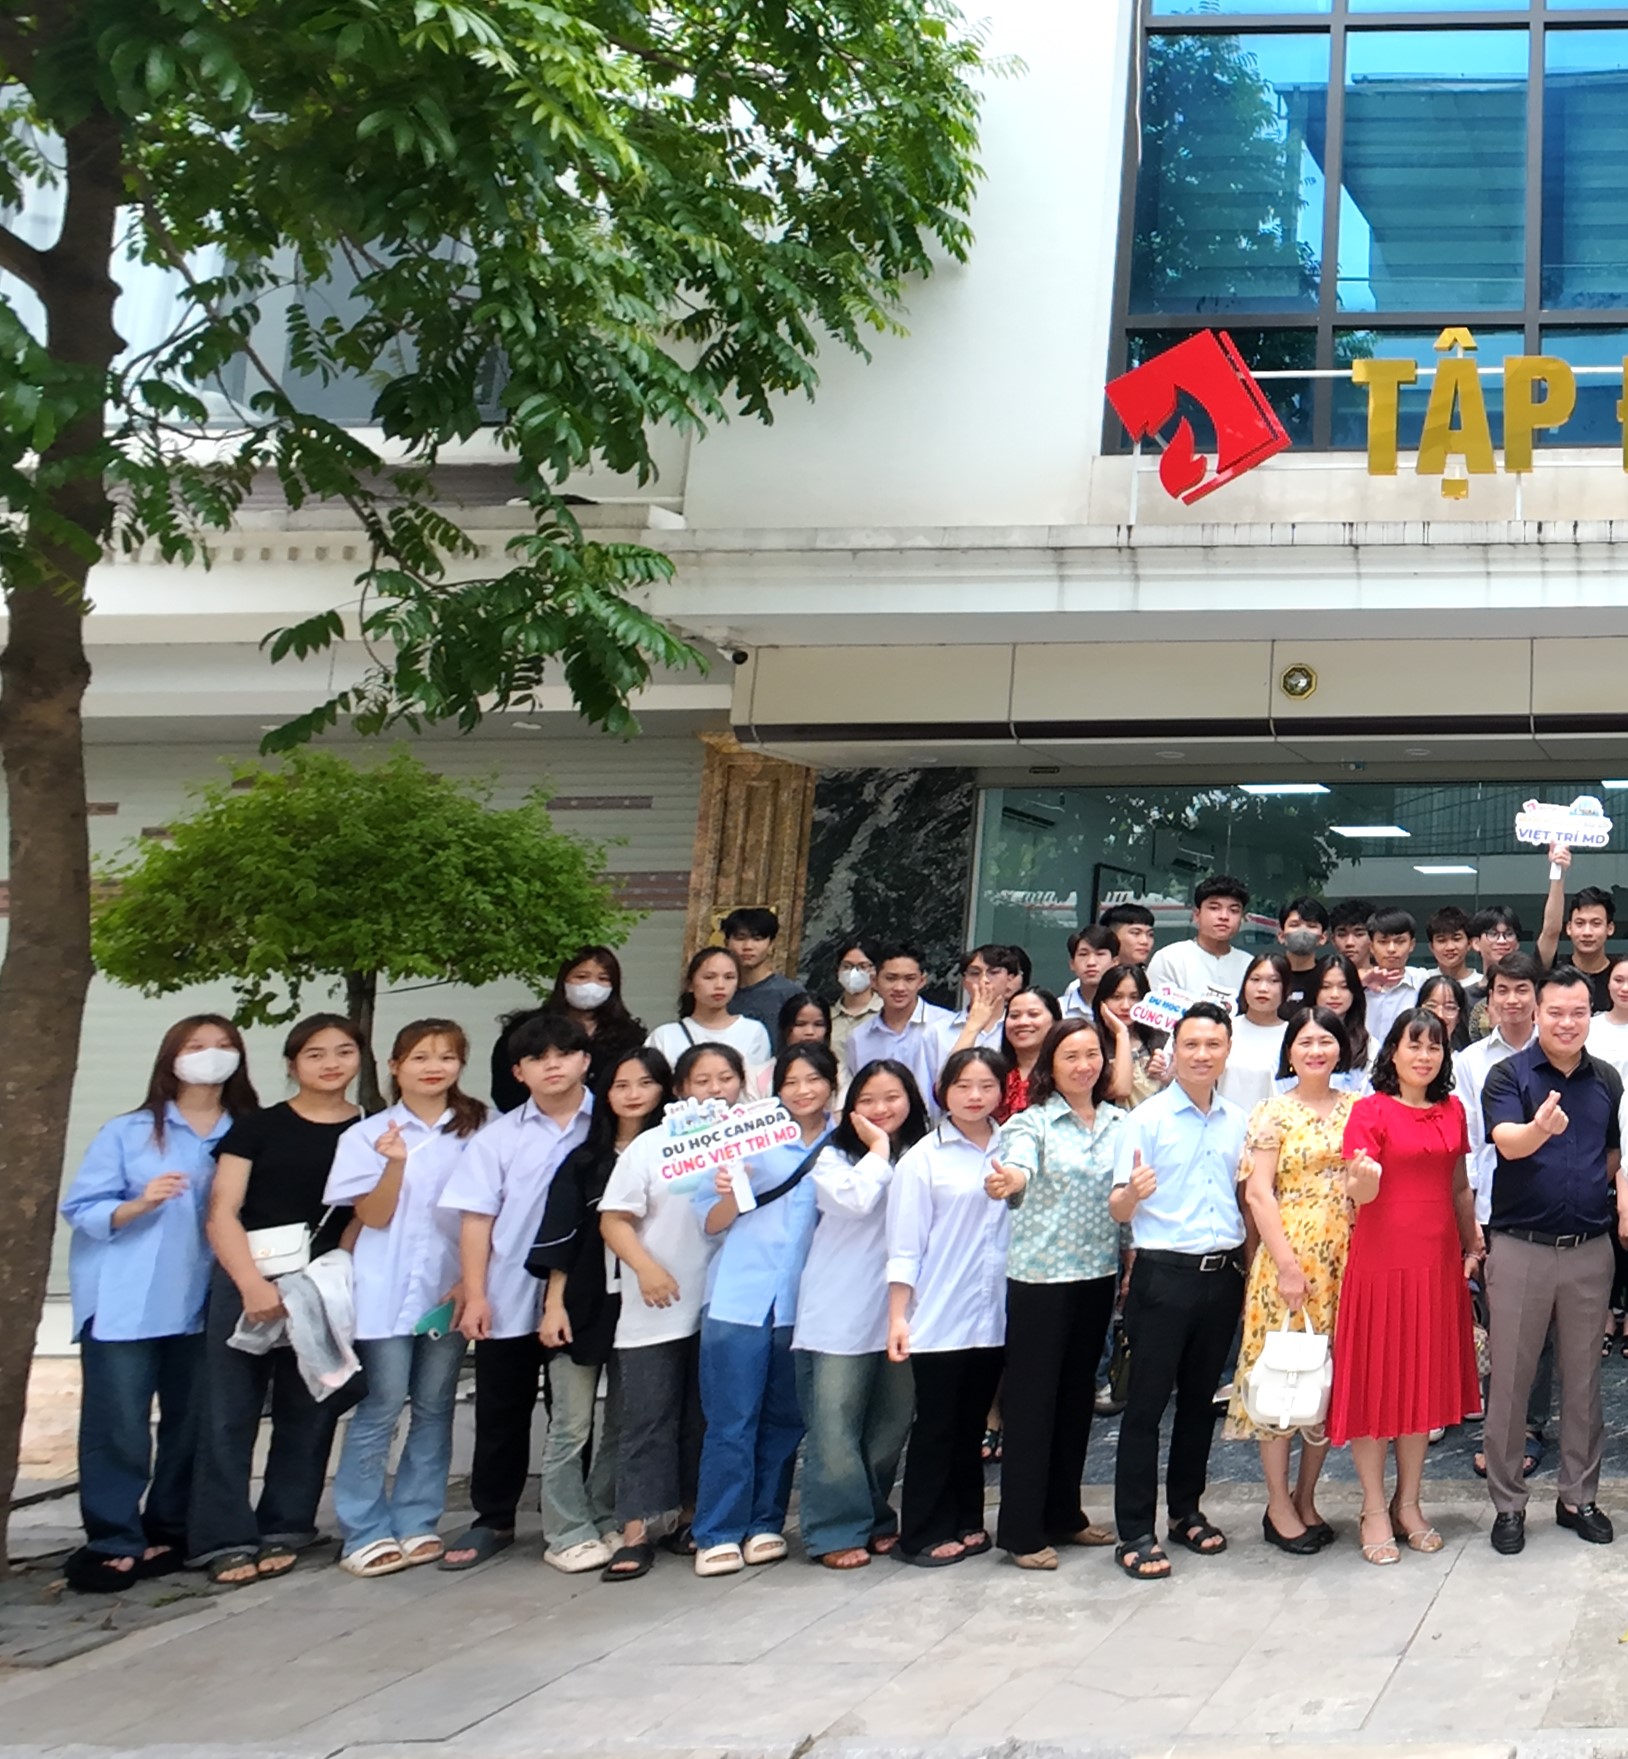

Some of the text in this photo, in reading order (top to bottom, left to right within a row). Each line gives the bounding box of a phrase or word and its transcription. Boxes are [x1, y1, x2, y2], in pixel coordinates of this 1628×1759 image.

[1352, 327, 1576, 500] TẬP
[1555, 830, 1579, 842] TRÍ
[1582, 833, 1606, 844] MD
[662, 1111, 786, 1158] DU HỌC CANADA
[662, 1125, 797, 1179] CÙNG VIỆT TRÍ MD
